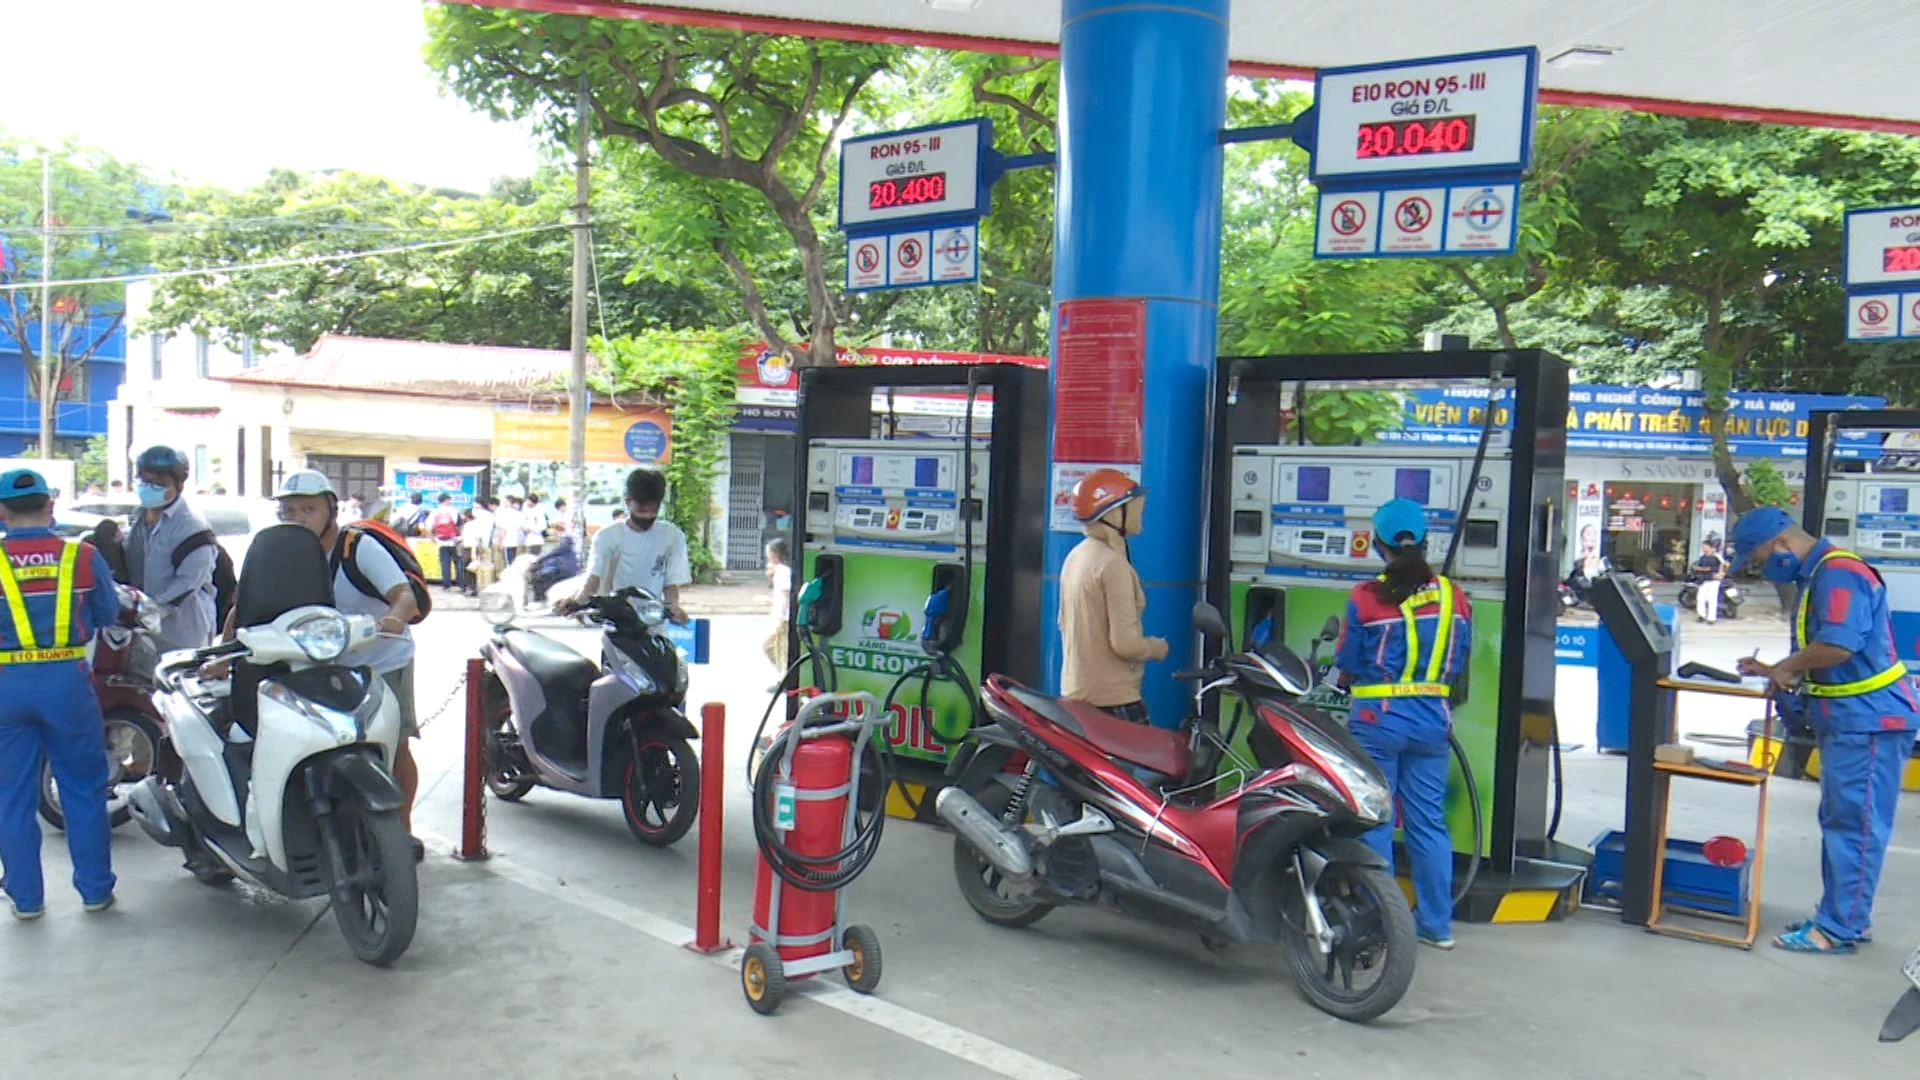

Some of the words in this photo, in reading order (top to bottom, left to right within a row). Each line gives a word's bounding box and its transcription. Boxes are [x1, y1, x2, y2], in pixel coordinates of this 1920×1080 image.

[1352, 83, 1381, 103] E10
[1385, 78, 1430, 99] RON
[1391, 100, 1419, 117] Giá
[1424, 98, 1452, 114] Đ/L
[1356, 118, 1468, 159] 20.040
[870, 142, 901, 160] RON
[885, 161, 905, 177] Giá
[907, 160, 926, 174] Đ/L
[869, 175, 944, 210] 20.400
[1415, 400, 1461, 429] VIỆN
[1584, 406, 1634, 432] PHÁT
[1638, 407, 1691, 434] TRIỂN
[1698, 412, 1749, 436] NÂN
[1756, 417, 1790, 441] LỰC
[832, 647, 867, 668] E10
